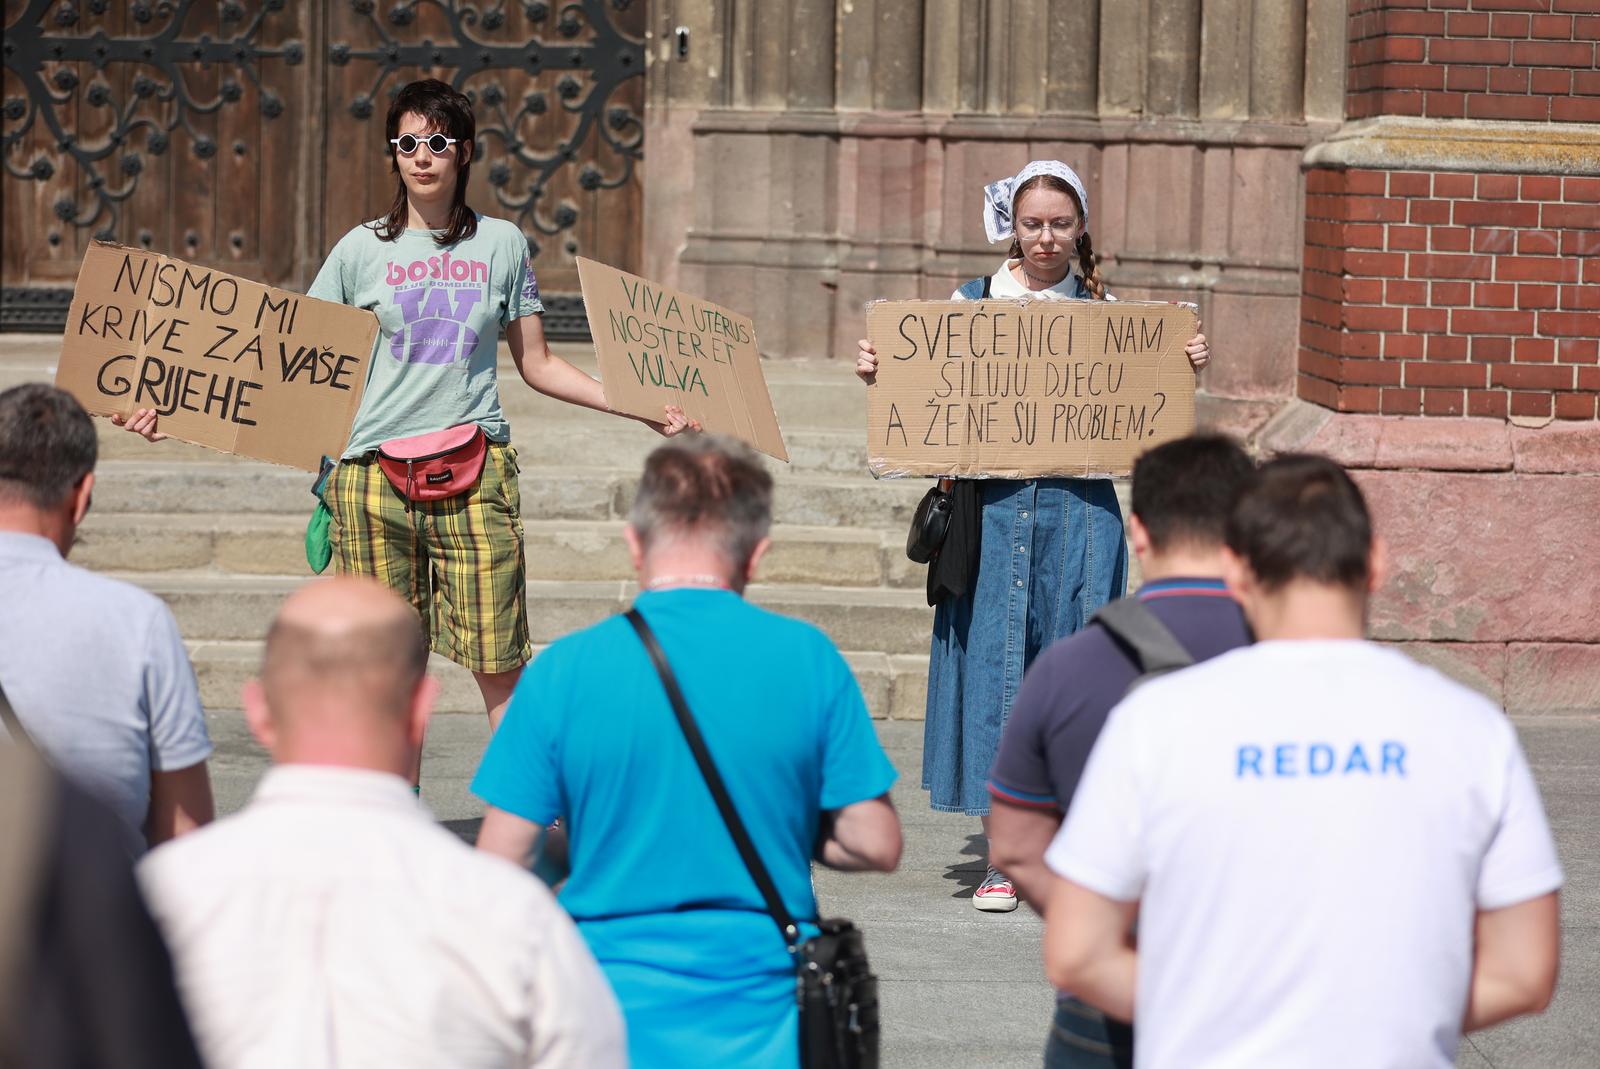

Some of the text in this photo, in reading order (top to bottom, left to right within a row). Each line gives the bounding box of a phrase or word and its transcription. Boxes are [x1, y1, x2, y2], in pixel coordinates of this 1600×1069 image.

[113, 254, 298, 335] NISMO MI
[386, 252, 487, 286] boston
[609, 309, 735, 365] NOSTER ET
[621, 277, 750, 344] VIVA UTERUS
[893, 306, 1164, 361] SVEĆENICI NAM
[79, 303, 360, 390] KRIVE ZA VAŠE
[628, 352, 708, 396] VULVA
[97, 355, 264, 426] GRIJEHE
[934, 361, 1123, 398] SILUJU DJECU
[885, 393, 1166, 446] A ŽENE SU PROBLEM?
[1236, 740, 1408, 778] REDAR
